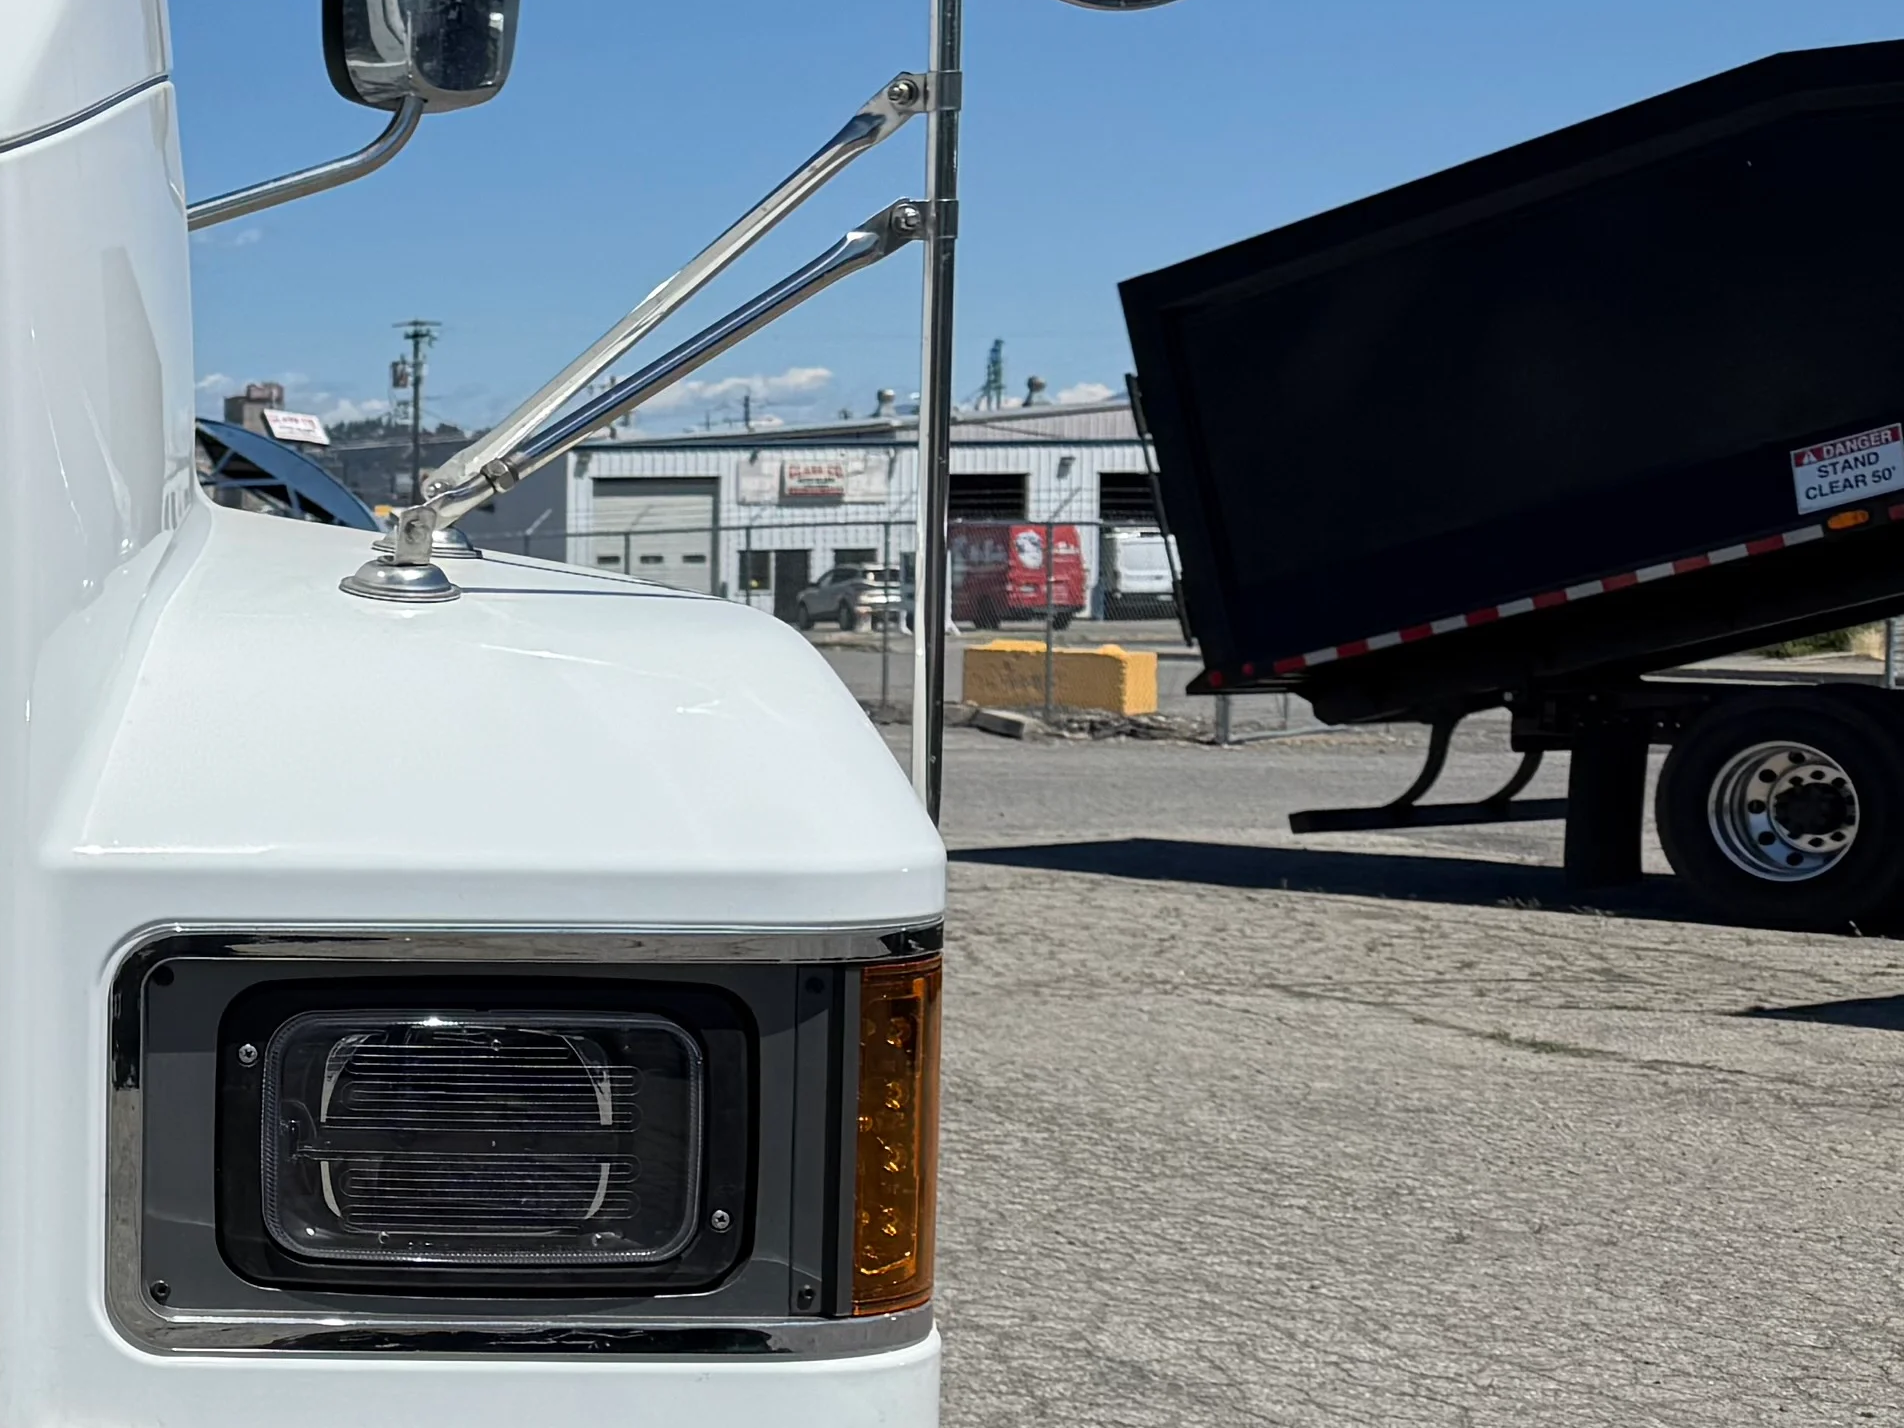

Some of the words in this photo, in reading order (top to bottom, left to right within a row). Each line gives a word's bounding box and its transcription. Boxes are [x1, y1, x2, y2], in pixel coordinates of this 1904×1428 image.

[1823, 430, 1893, 460] DANGER
[1817, 452, 1880, 479] STAND
[1805, 474, 1868, 501] CLEAR
[1872, 466, 1897, 484] 50'
